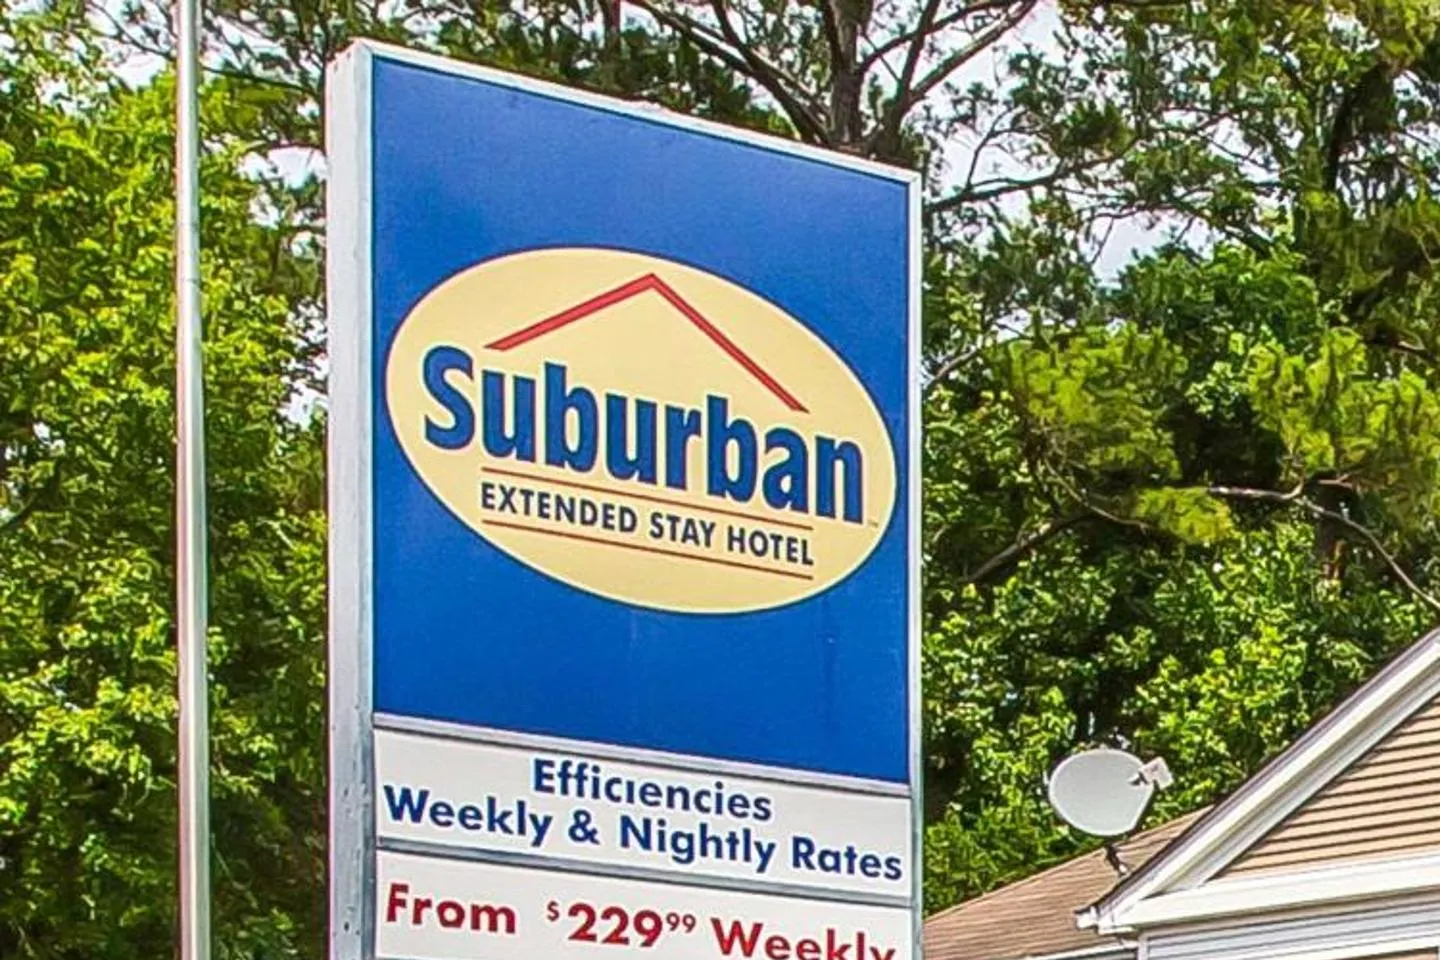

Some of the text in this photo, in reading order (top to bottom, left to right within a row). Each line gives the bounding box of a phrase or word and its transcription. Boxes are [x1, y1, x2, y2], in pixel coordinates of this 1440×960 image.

[422, 344, 865, 526] Suburban
[480, 481, 815, 567] EXTENDED STAY HOTEL
[533, 757, 773, 822] Efficiencies
[383, 784, 904, 882] Weekly & Nightly Rates
[386, 883, 517, 934] From
